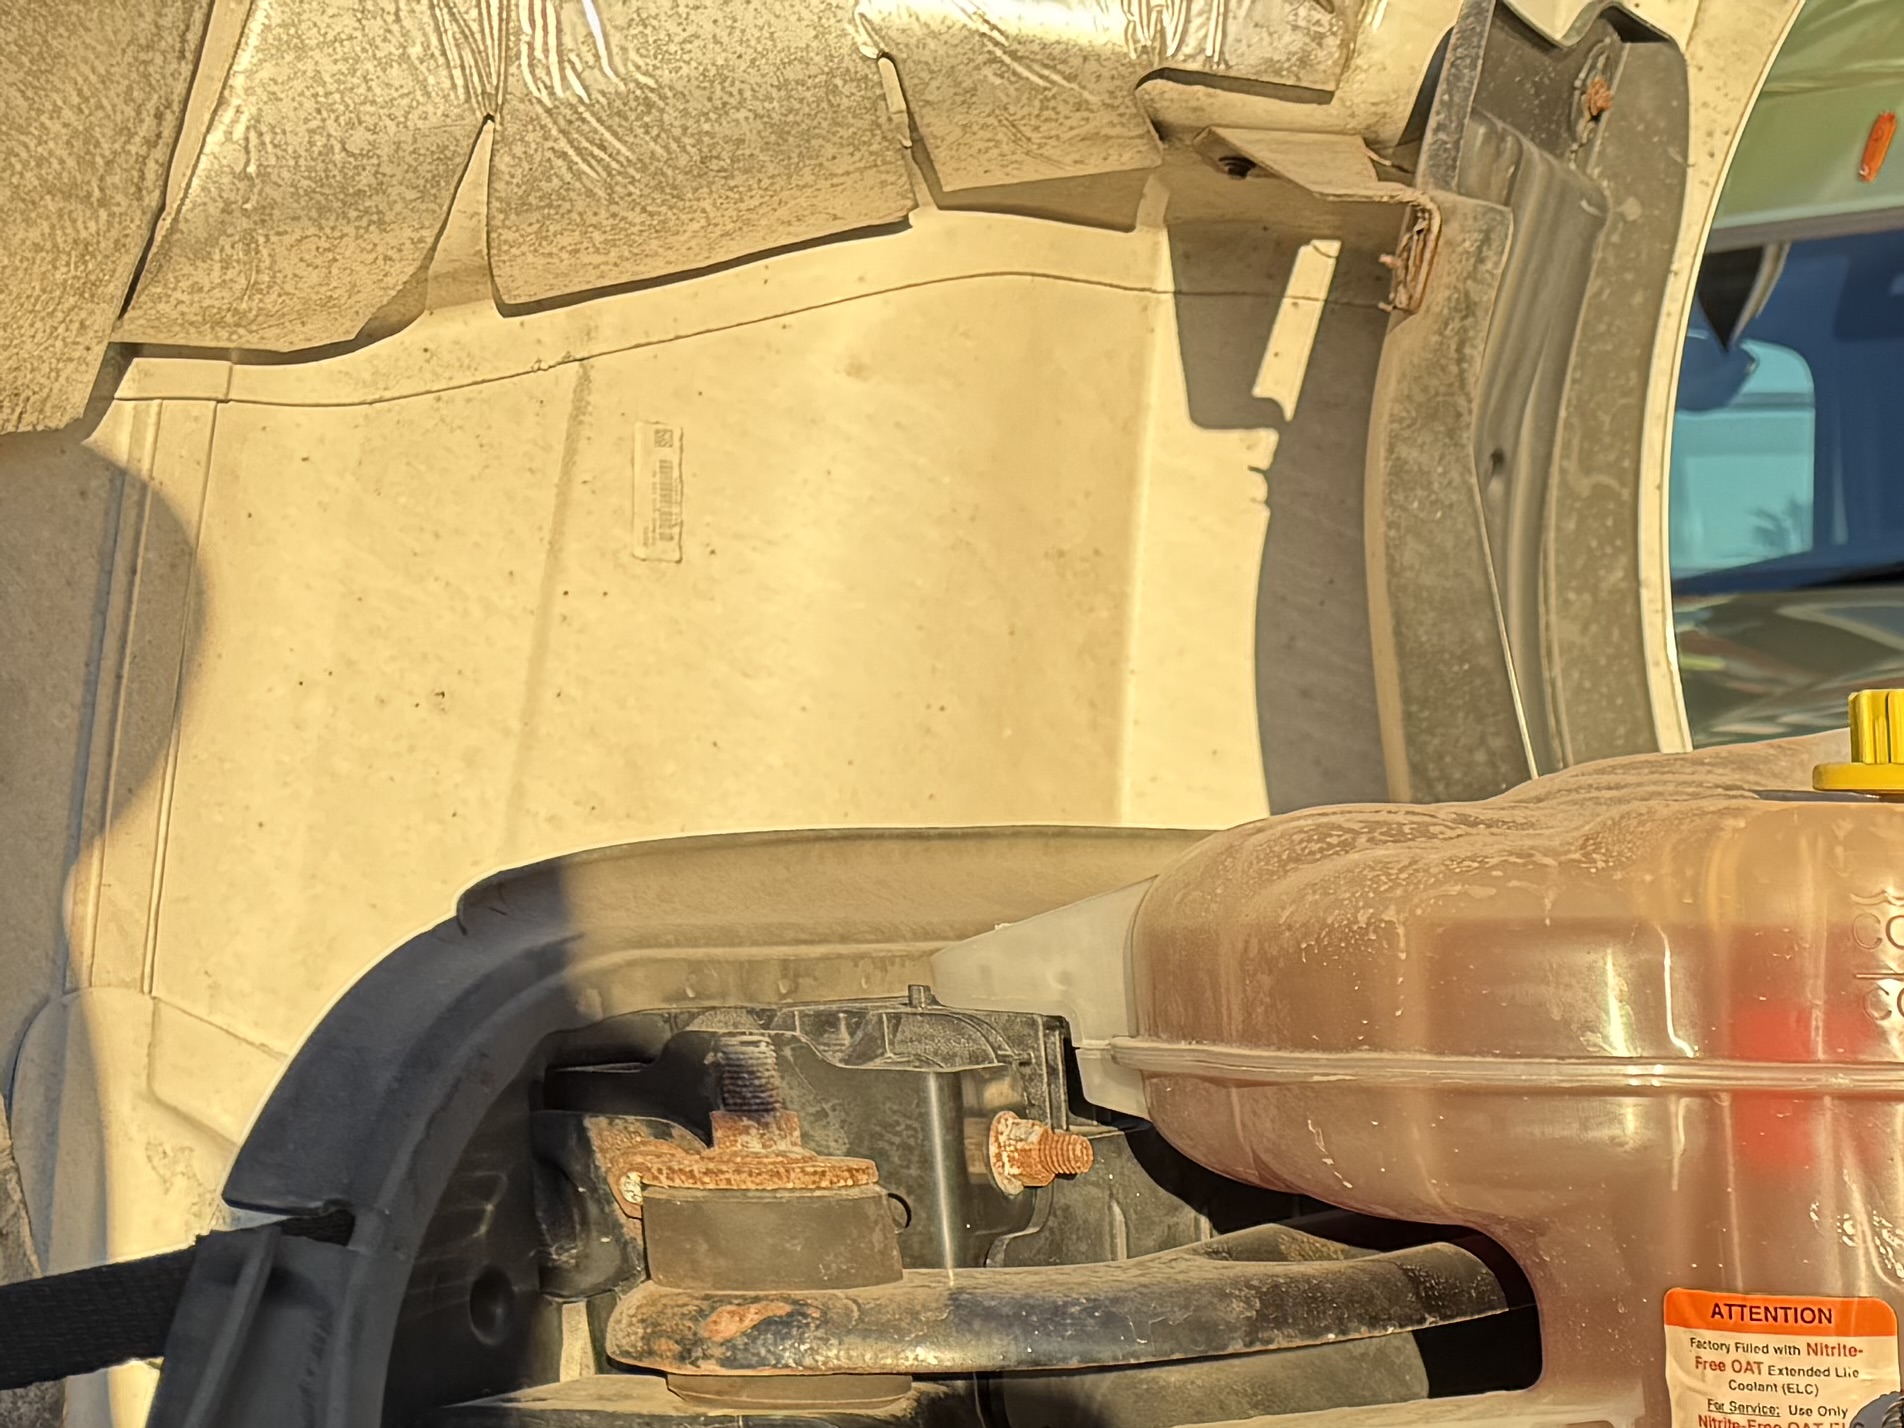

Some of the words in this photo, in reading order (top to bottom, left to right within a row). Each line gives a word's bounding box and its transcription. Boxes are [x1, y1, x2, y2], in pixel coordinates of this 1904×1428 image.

[1711, 1302, 1833, 1325] ATTENTION
[1689, 1337, 1731, 1355] Factory
[1734, 1341, 1769, 1355] Filled
[1773, 1343, 1801, 1356] with
[1806, 1342, 1864, 1358] Nitrite-
[1694, 1356, 1727, 1373] Free
[1731, 1359, 1765, 1376] OAT
[1767, 1361, 1831, 1378] Extended
[1728, 1379, 1779, 1394] Coolant
[1781, 1382, 1820, 1398] (ELC)
[1707, 1398, 1726, 1414] For
[1788, 1405, 1814, 1418] Use
[1817, 1406, 1849, 1420] Only
